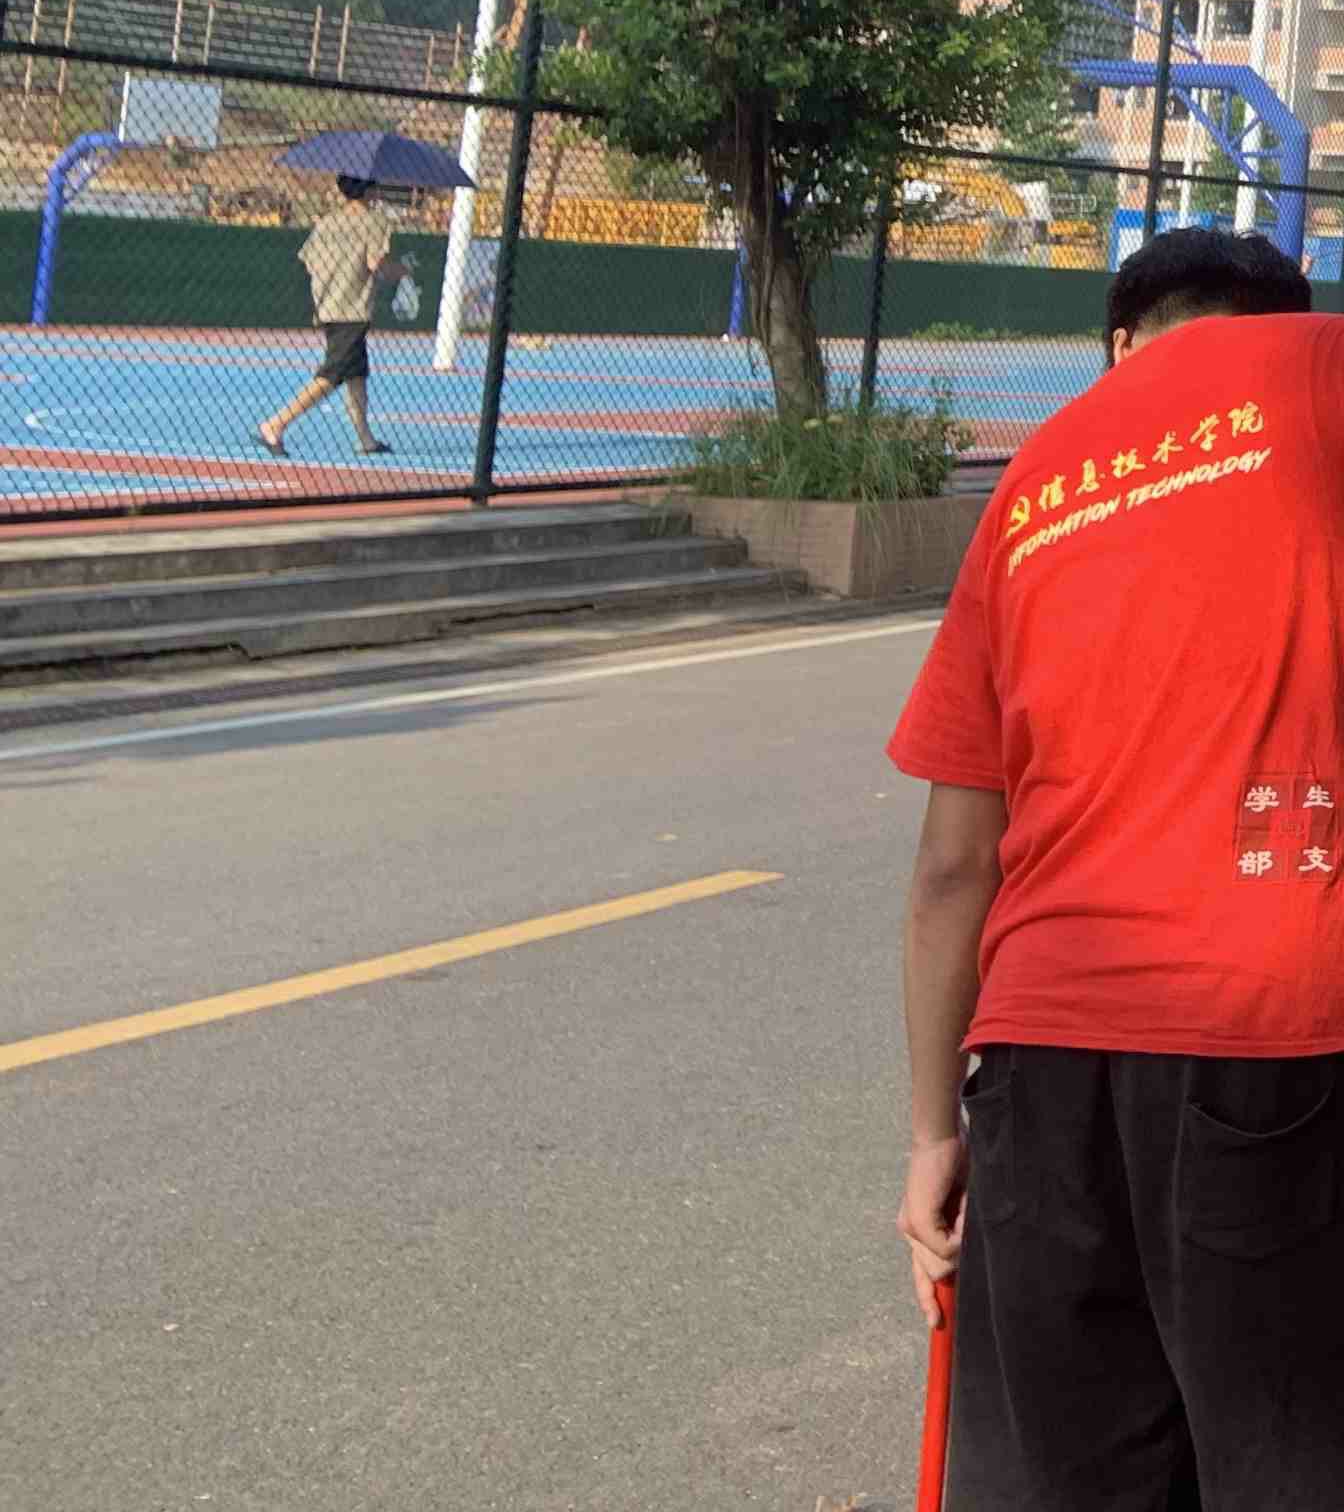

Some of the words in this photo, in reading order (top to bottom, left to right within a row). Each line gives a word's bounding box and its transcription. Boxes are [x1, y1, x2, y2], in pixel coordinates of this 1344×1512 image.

[1038, 401, 1264, 512] 信息技术学院
[1126, 447, 1272, 510] TECHNOLOGY
[1244, 785, 1335, 813] 学生
